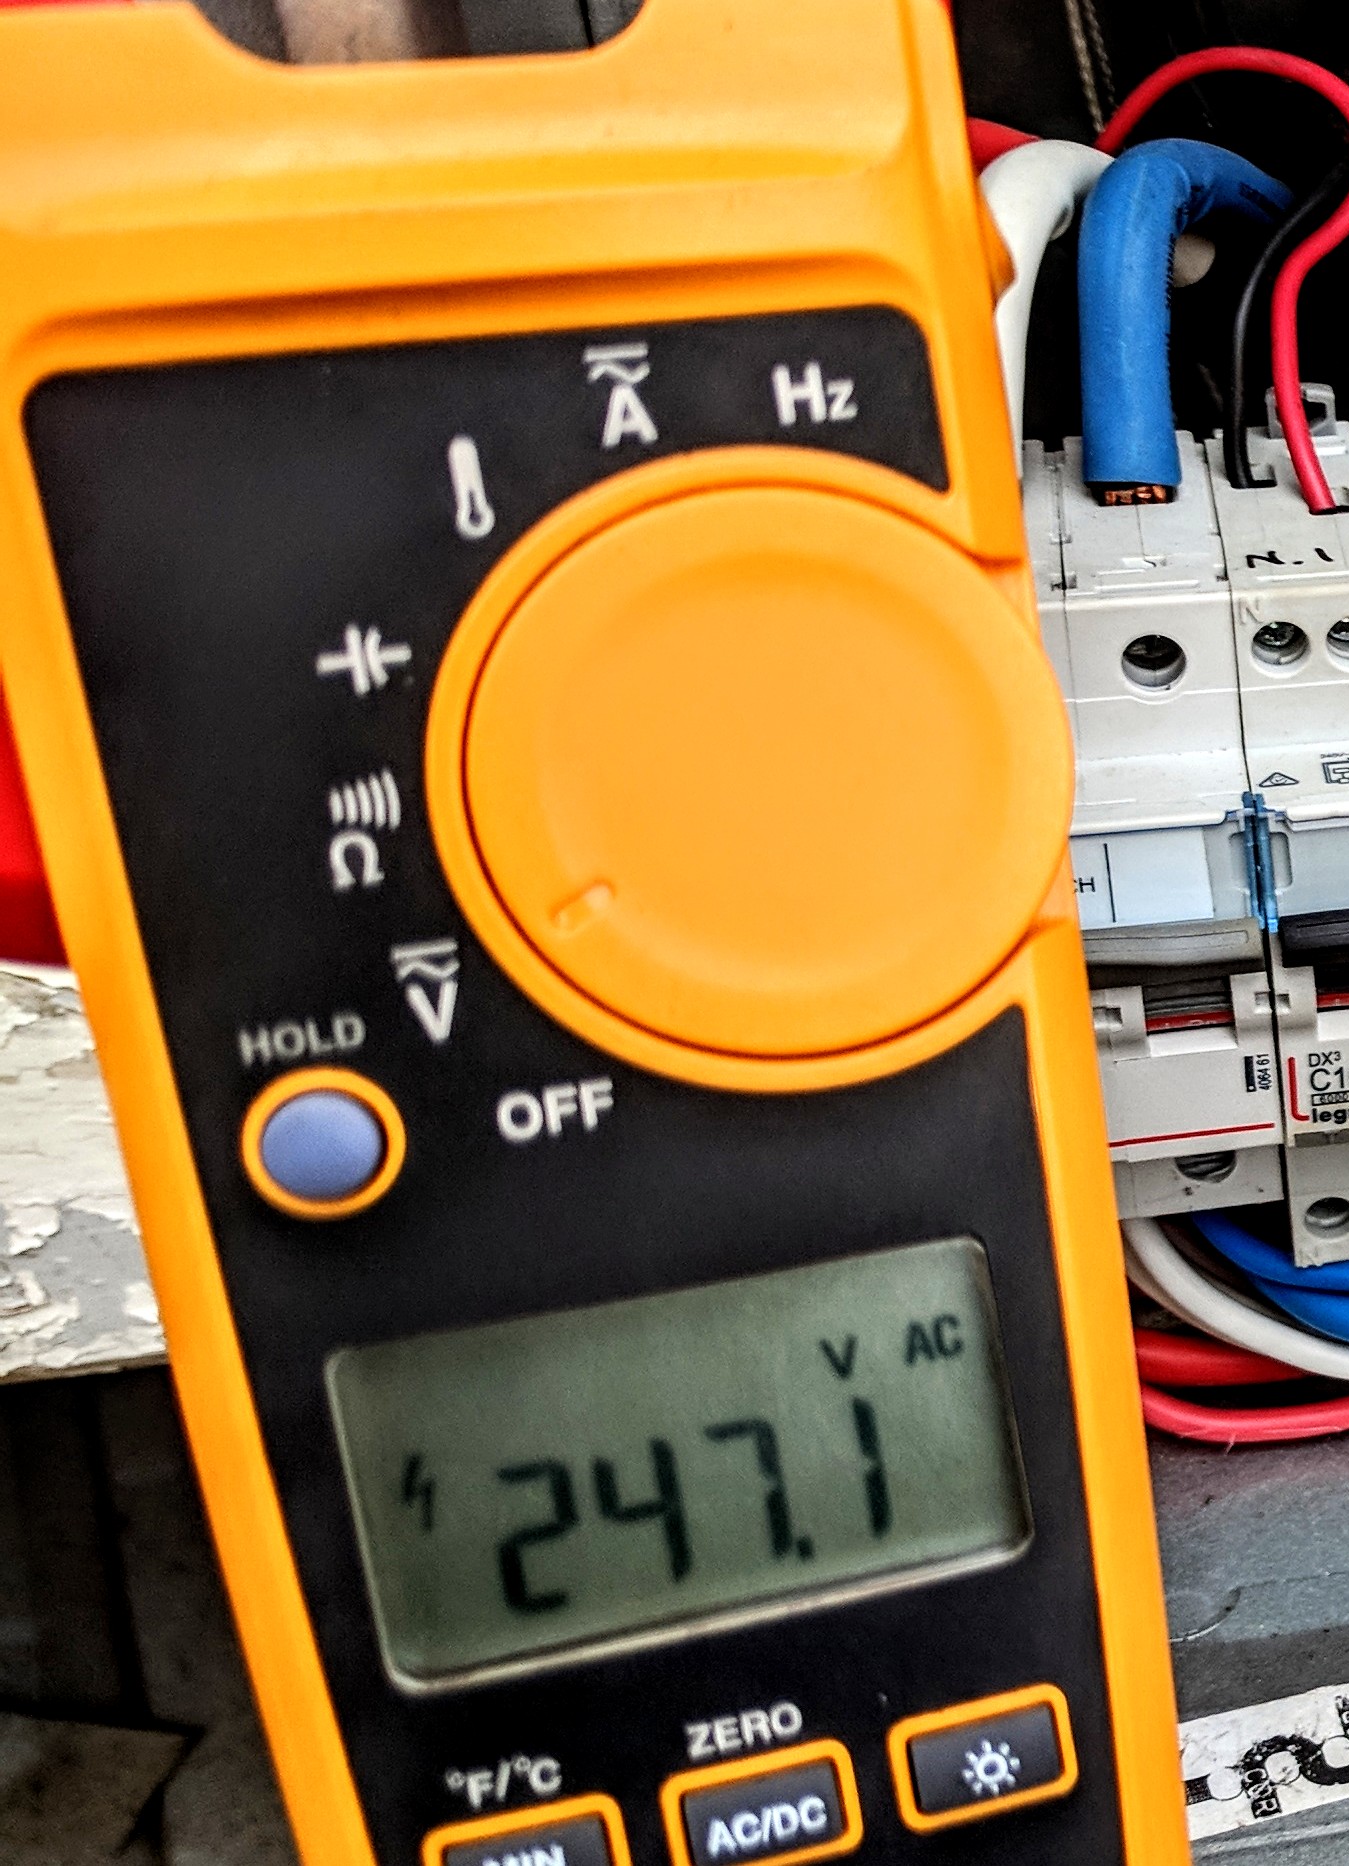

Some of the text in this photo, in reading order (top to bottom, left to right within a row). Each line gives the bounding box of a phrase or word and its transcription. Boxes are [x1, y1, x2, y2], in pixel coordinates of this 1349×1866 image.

[772, 362, 858, 425] Hz
[1246, 547, 1334, 569] N.1
[239, 1013, 366, 1065] HOLD
[407, 982, 458, 1042] V
[497, 1076, 614, 1142] OFF
[819, 1314, 963, 1381] V AC
[496, 1397, 892, 1613] 247.1
[684, 1702, 803, 1760] ZERO
[706, 1796, 828, 1859] AC/DC
